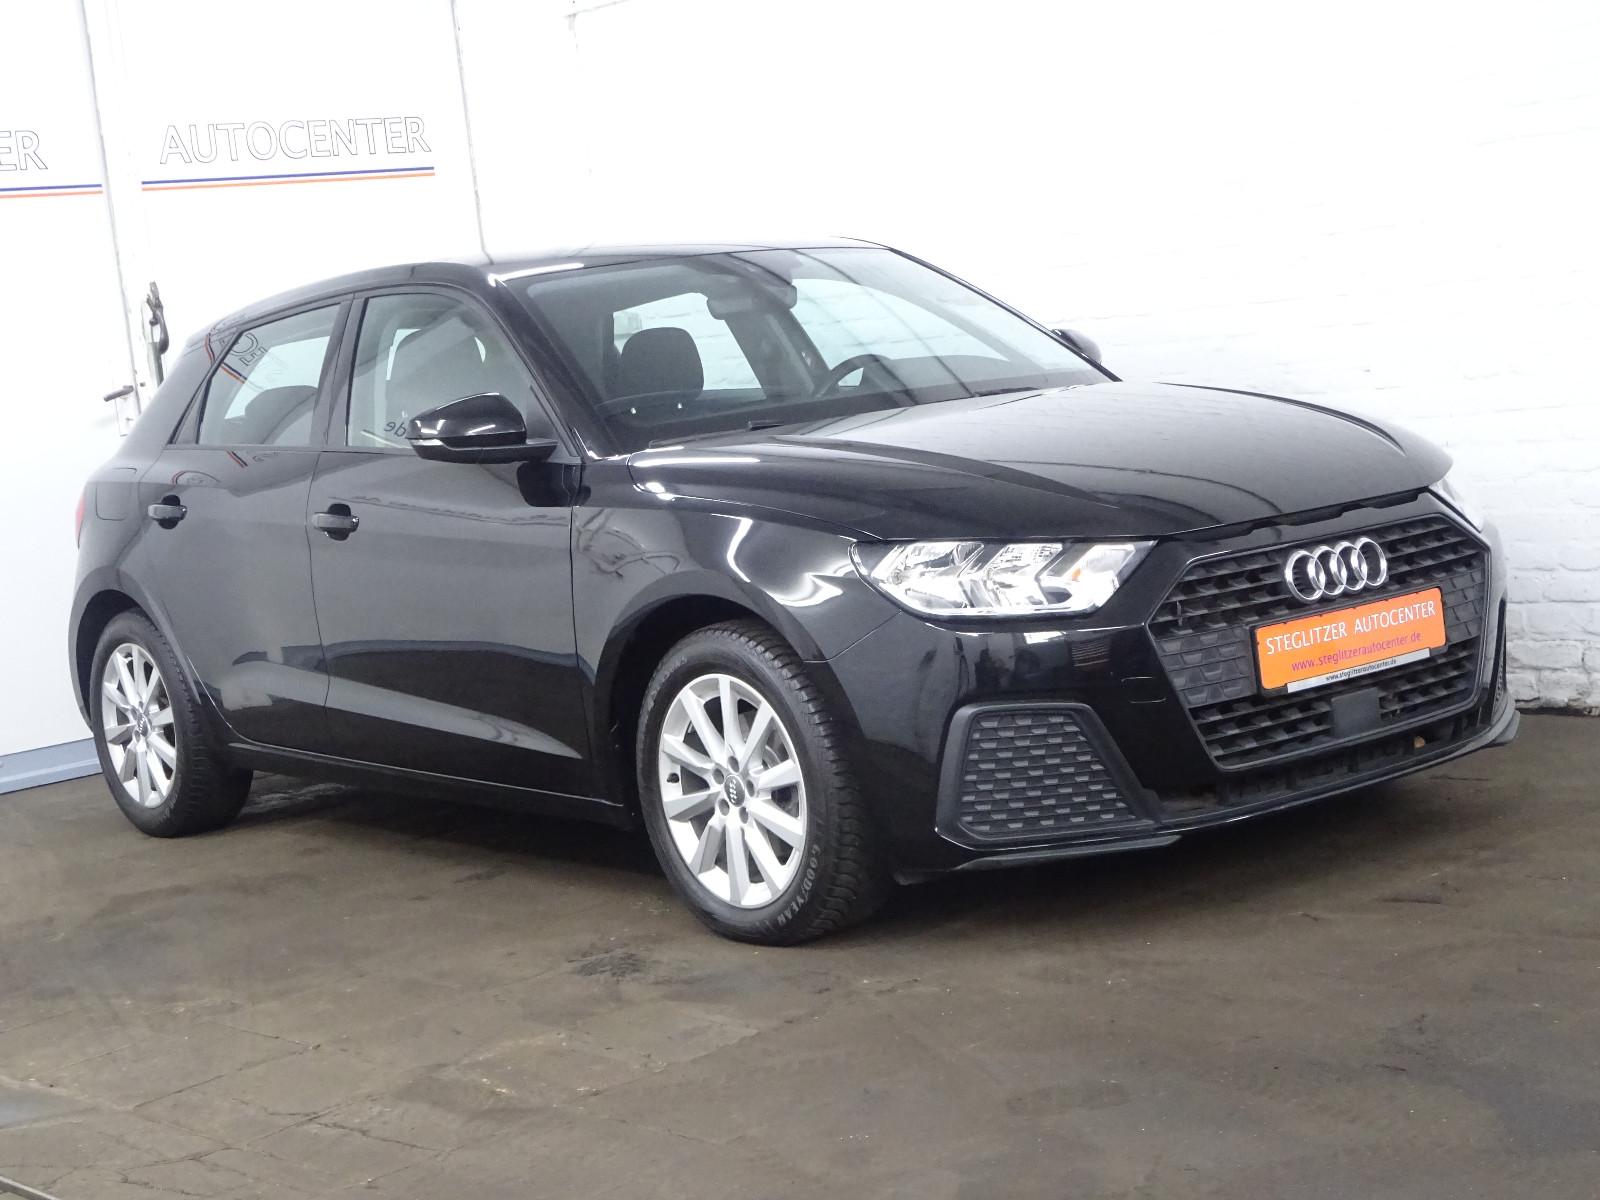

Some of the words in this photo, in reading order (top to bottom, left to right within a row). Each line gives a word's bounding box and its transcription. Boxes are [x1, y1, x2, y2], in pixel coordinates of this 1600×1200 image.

[160, 117, 431, 164] AUTOCENTER
[1266, 622, 1348, 655] STEGLITZER
[1354, 600, 1436, 634] AUTOCENTER
[1291, 631, 1422, 672] www.steglitzerautocenter.de
